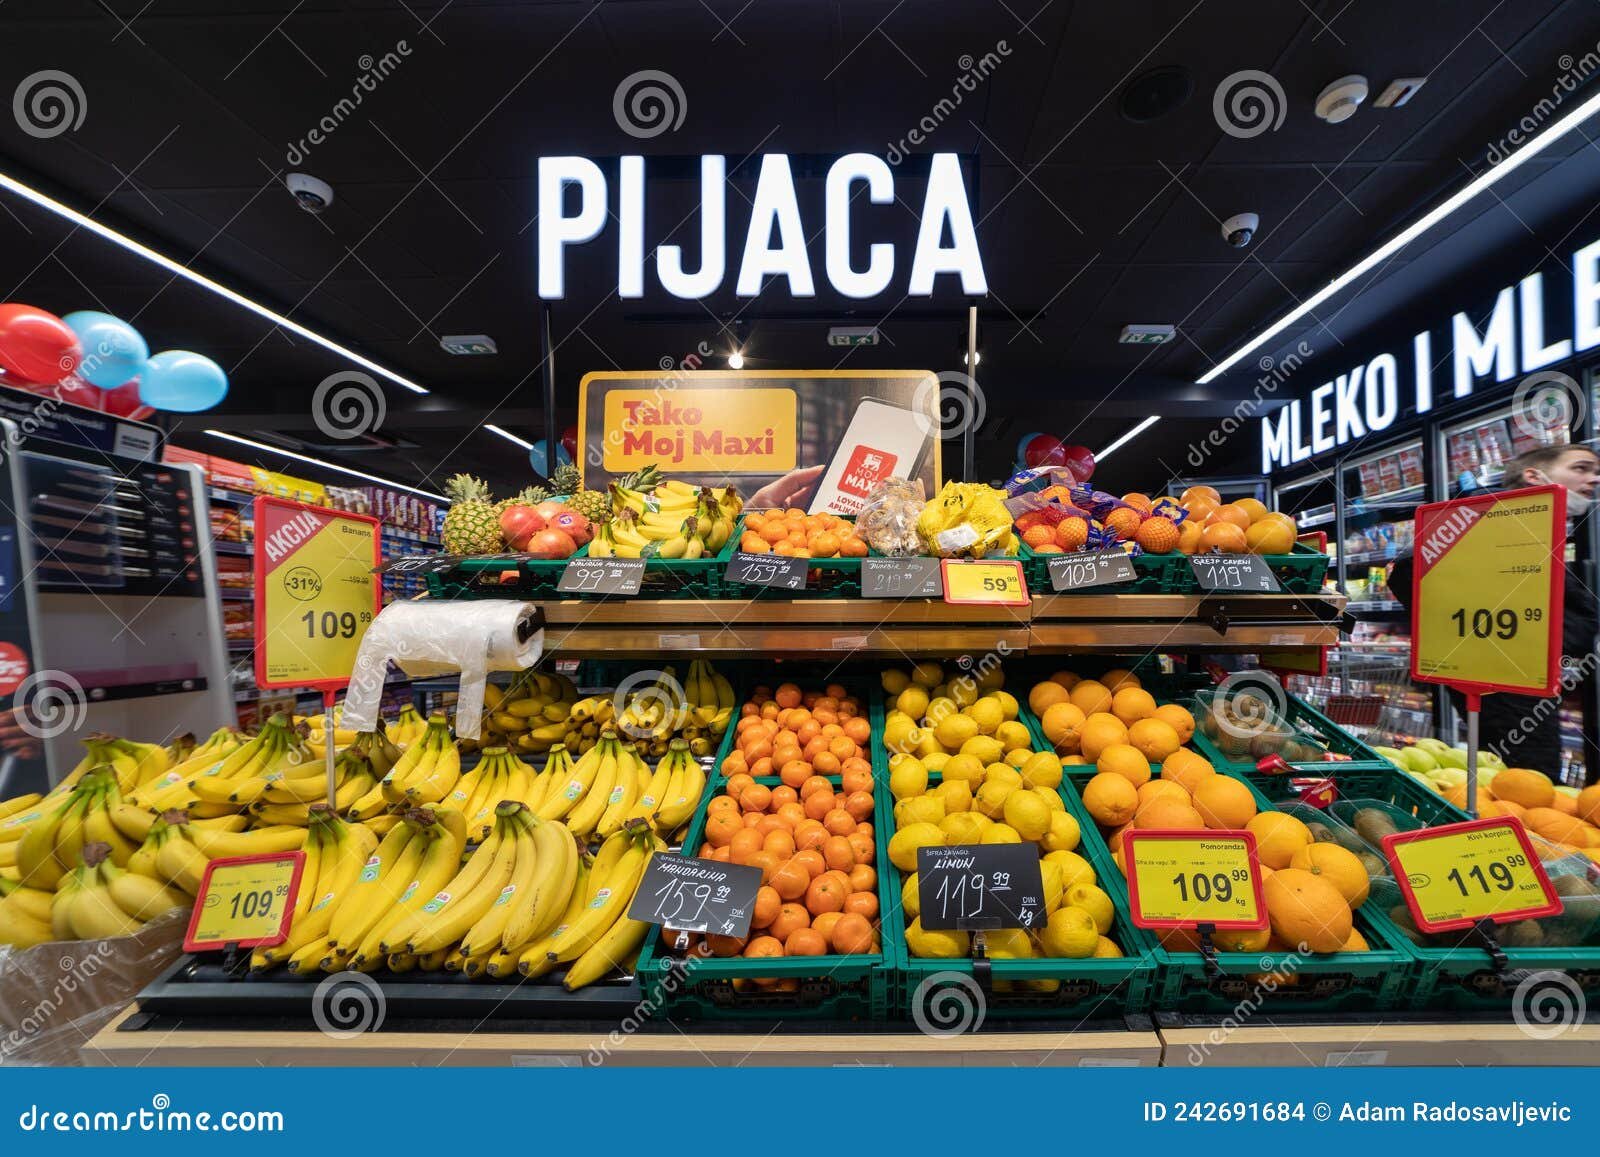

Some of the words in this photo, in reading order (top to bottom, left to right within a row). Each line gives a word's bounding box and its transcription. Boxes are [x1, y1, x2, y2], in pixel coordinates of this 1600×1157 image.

[537, 152, 988, 299] PIJACA
[622, 401, 703, 426] Tako
[1261, 353, 1398, 475] MLEKO
[1413, 330, 1433, 414] I
[622, 430, 685, 463] Moj
[692, 429, 774, 455] Maxi
[1480, 503, 1550, 519] Pomorandza
[264, 510, 323, 563] AKCIJA
[1420, 504, 1480, 565] AKCIJA
[285, 577, 321, 592] -31%
[564, 568, 605, 590] 99
[740, 563, 778, 583] 159
[983, 578, 1007, 592] 59
[1060, 562, 1097, 587] 109
[1206, 566, 1243, 588] 119
[301, 610, 357, 639] 109
[360, 611, 372, 623] 99
[1451, 607, 1518, 640] 109
[1524, 607, 1543, 622] 99
[1200, 843, 1246, 851] Pomorandza
[1467, 833, 1483, 841] Kivi
[1485, 829, 1514, 840] korpica
[657, 862, 727, 883] MANDARINA
[1447, 861, 1515, 897] 119
[1506, 854, 1526, 868] 99
[935, 874, 985, 919] 119
[992, 871, 1011, 886] 99
[1173, 872, 1233, 903] 109
[1231, 869, 1249, 882] 99
[230, 890, 274, 919] 109
[275, 884, 289, 896] 99
[654, 877, 712, 922] 159
[716, 885, 732, 899] 99
[1022, 896, 1036, 904] DIN
[1235, 897, 1246, 907] kg
